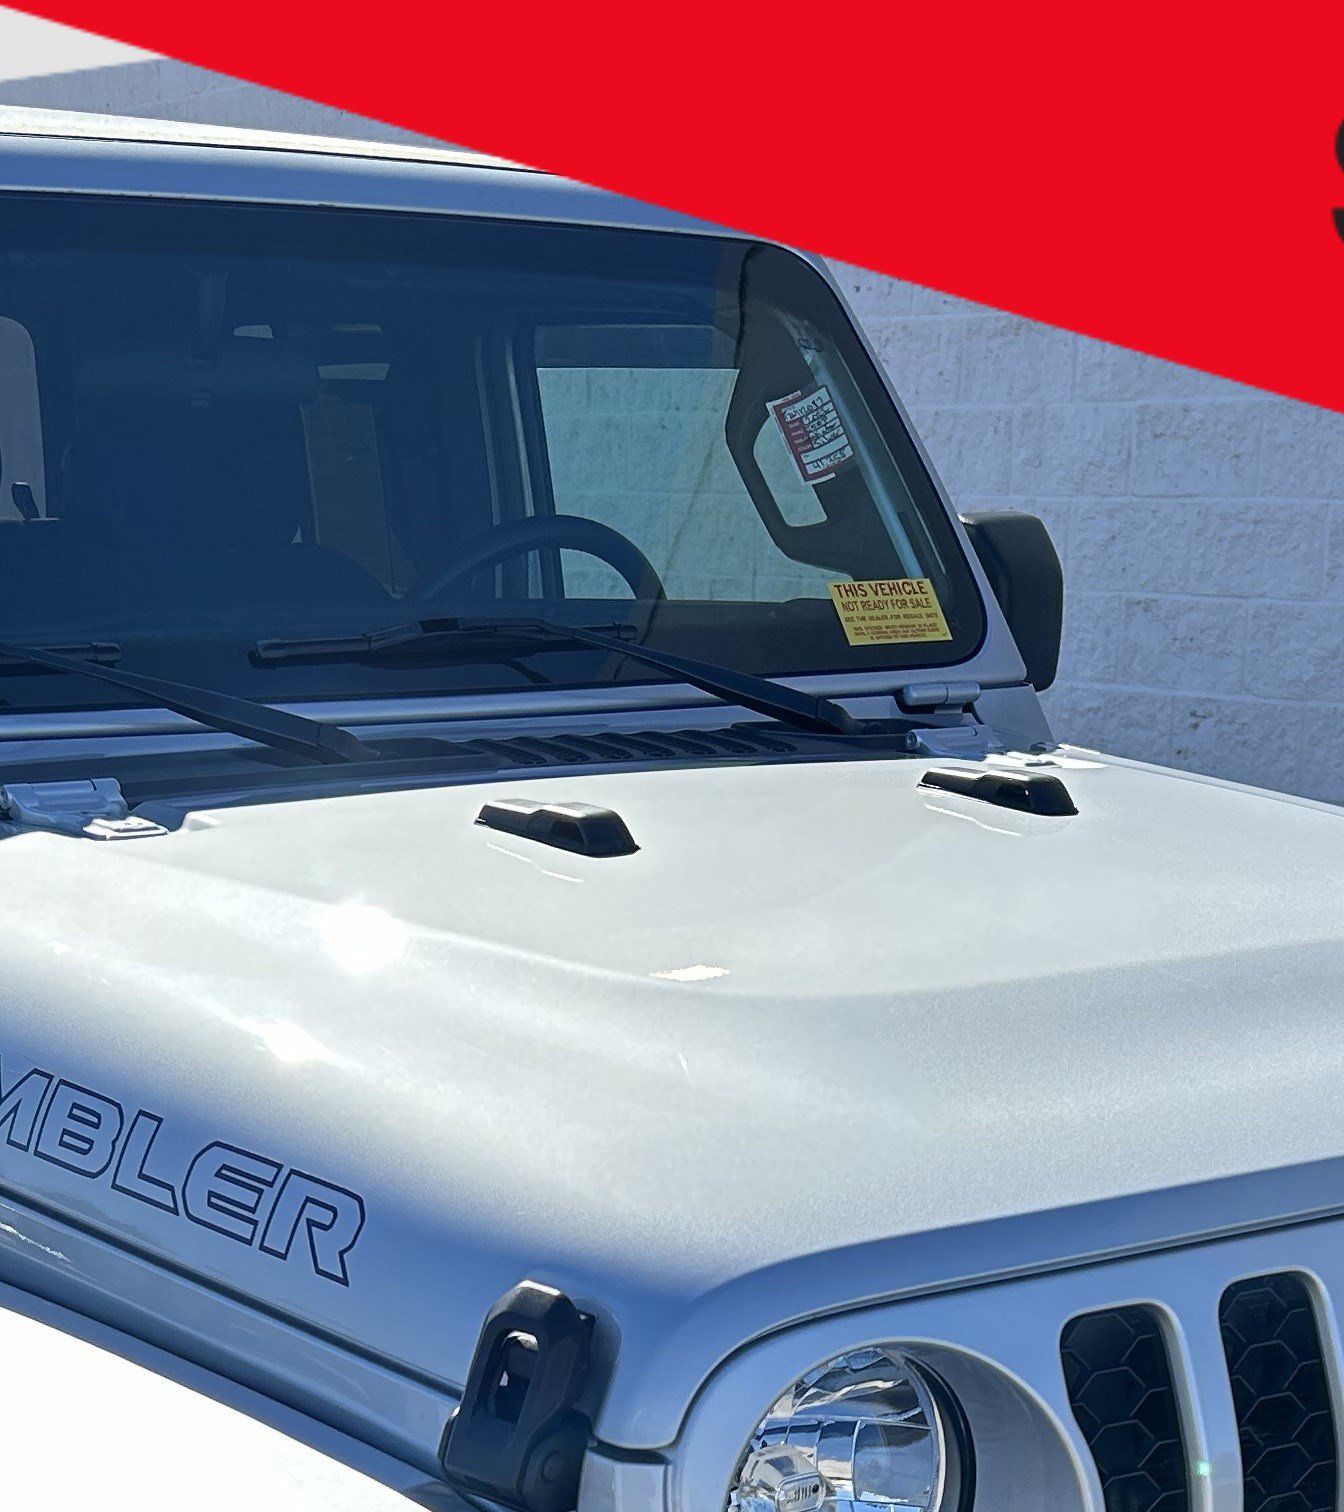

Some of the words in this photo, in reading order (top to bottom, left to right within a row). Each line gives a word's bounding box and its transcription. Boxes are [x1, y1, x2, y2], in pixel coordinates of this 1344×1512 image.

[834, 583, 867, 598] THIS
[868, 580, 928, 596] VEHICLE
[841, 600, 859, 612] NOT
[861, 599, 889, 611] READY
[890, 599, 910, 610] FOR
[910, 597, 932, 609] SALE
